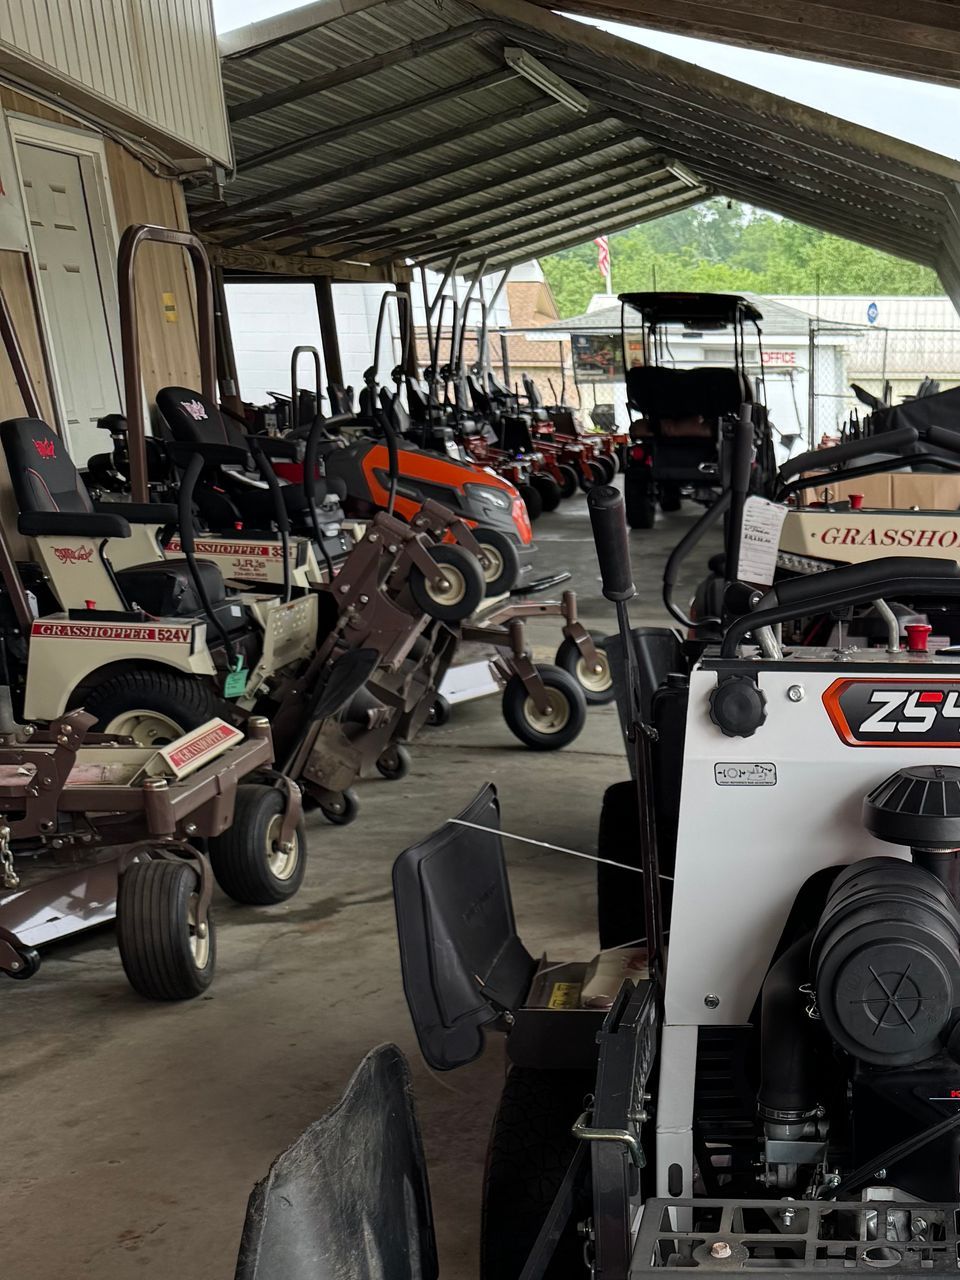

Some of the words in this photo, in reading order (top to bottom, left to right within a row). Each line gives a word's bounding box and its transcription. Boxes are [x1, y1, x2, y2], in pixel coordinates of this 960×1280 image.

[761, 351, 796, 363] OFFICE
[171, 542, 264, 555] GSSHOPPER
[40, 625, 150, 640] GRASSHOPPER
[157, 629, 190, 642] 524V
